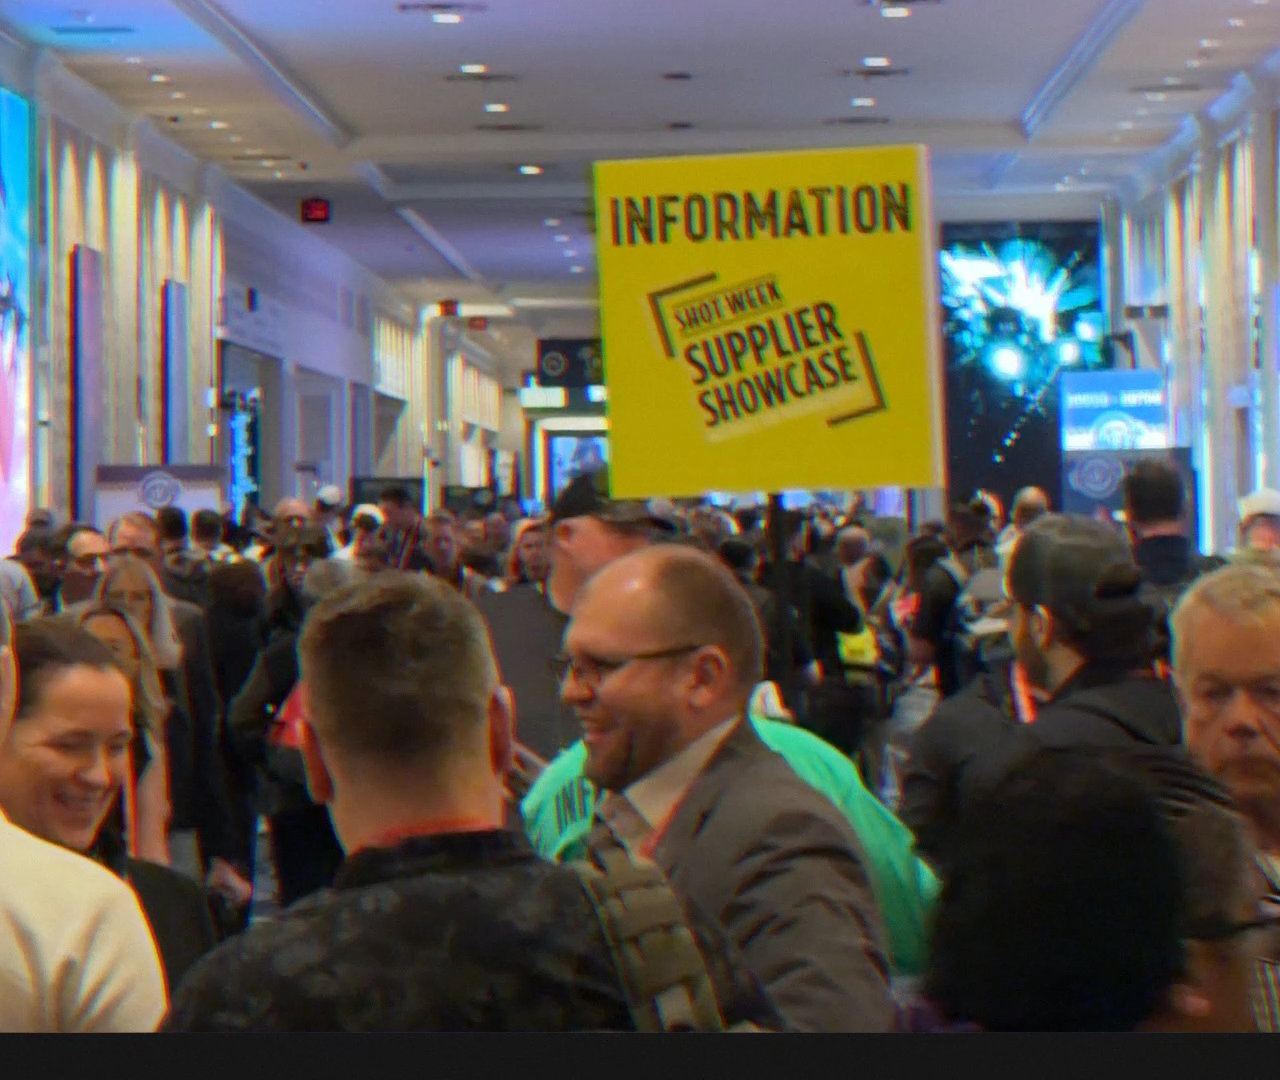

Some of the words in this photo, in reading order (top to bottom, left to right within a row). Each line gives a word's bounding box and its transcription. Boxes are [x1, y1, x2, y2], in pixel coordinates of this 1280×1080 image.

[610, 182, 913, 247] INFORMATION
[674, 297, 723, 331] SHOT
[725, 280, 785, 316] WEEK
[684, 301, 843, 386] SUPPLIER
[698, 345, 858, 428] SHOWCASE
